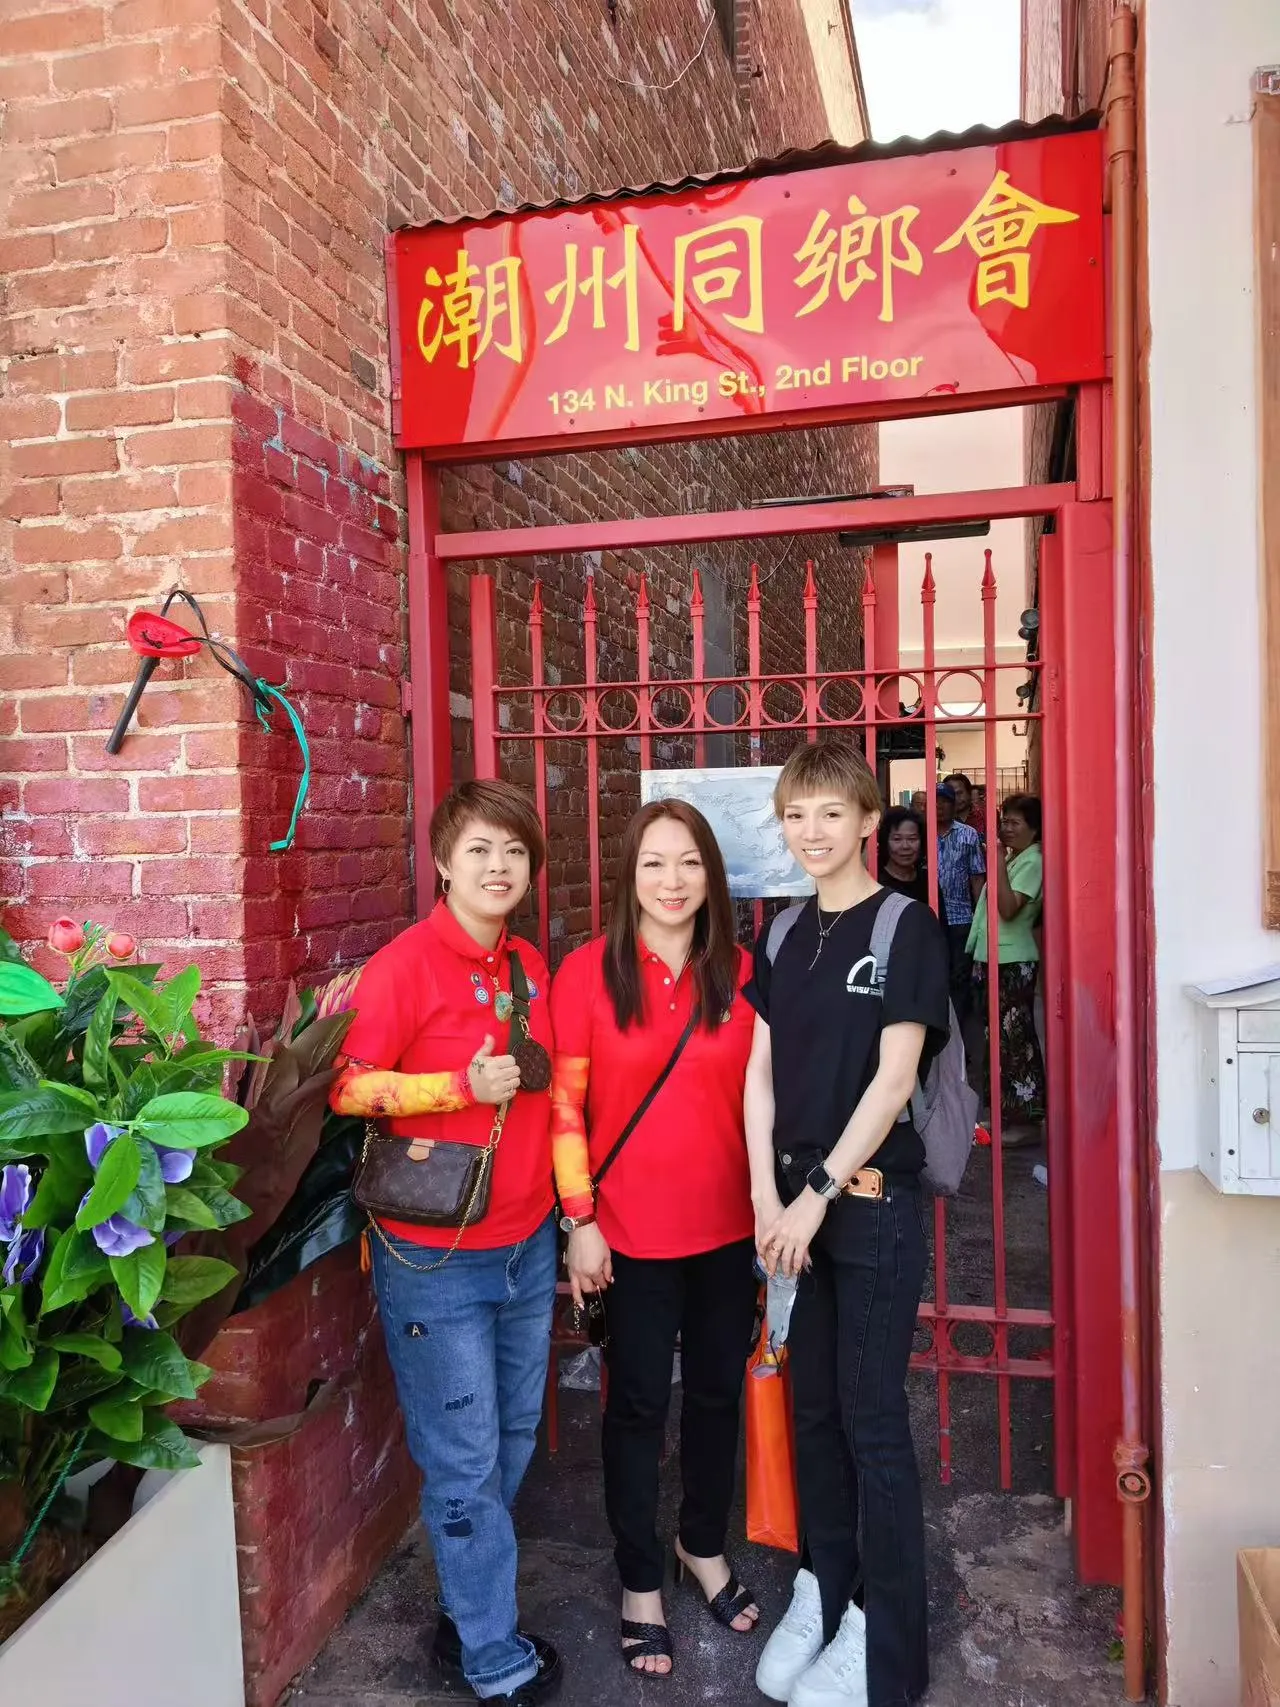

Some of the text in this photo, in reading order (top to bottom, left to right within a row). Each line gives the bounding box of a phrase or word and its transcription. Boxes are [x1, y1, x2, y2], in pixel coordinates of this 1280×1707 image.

[418, 171, 1079, 369] 潮州同鄉會
[547, 354, 924, 416] 134 N. King St., 2nd Floor
[412, 1324, 421, 1337] A
